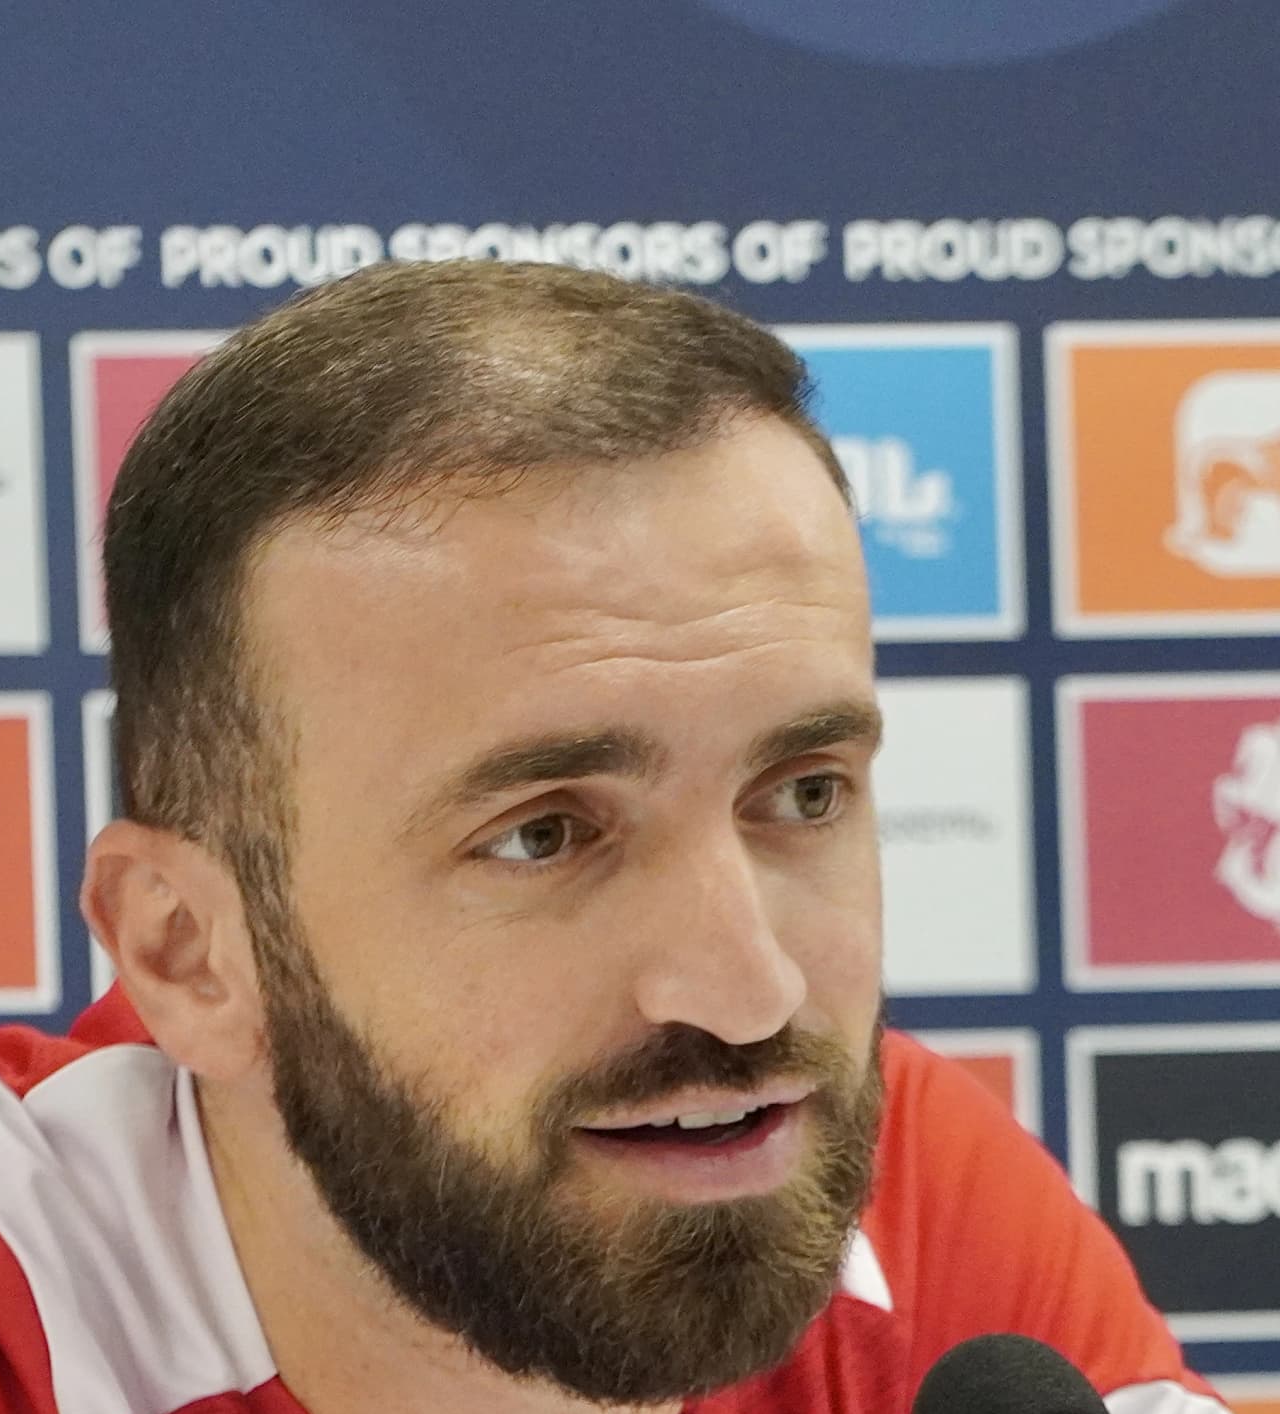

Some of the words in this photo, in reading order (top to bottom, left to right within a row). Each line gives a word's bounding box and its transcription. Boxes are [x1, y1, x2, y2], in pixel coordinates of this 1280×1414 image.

[48, 226, 141, 289] OF
[161, 225, 382, 288] PROUD
[733, 221, 826, 283] OF
[843, 219, 1064, 280] PROUD
